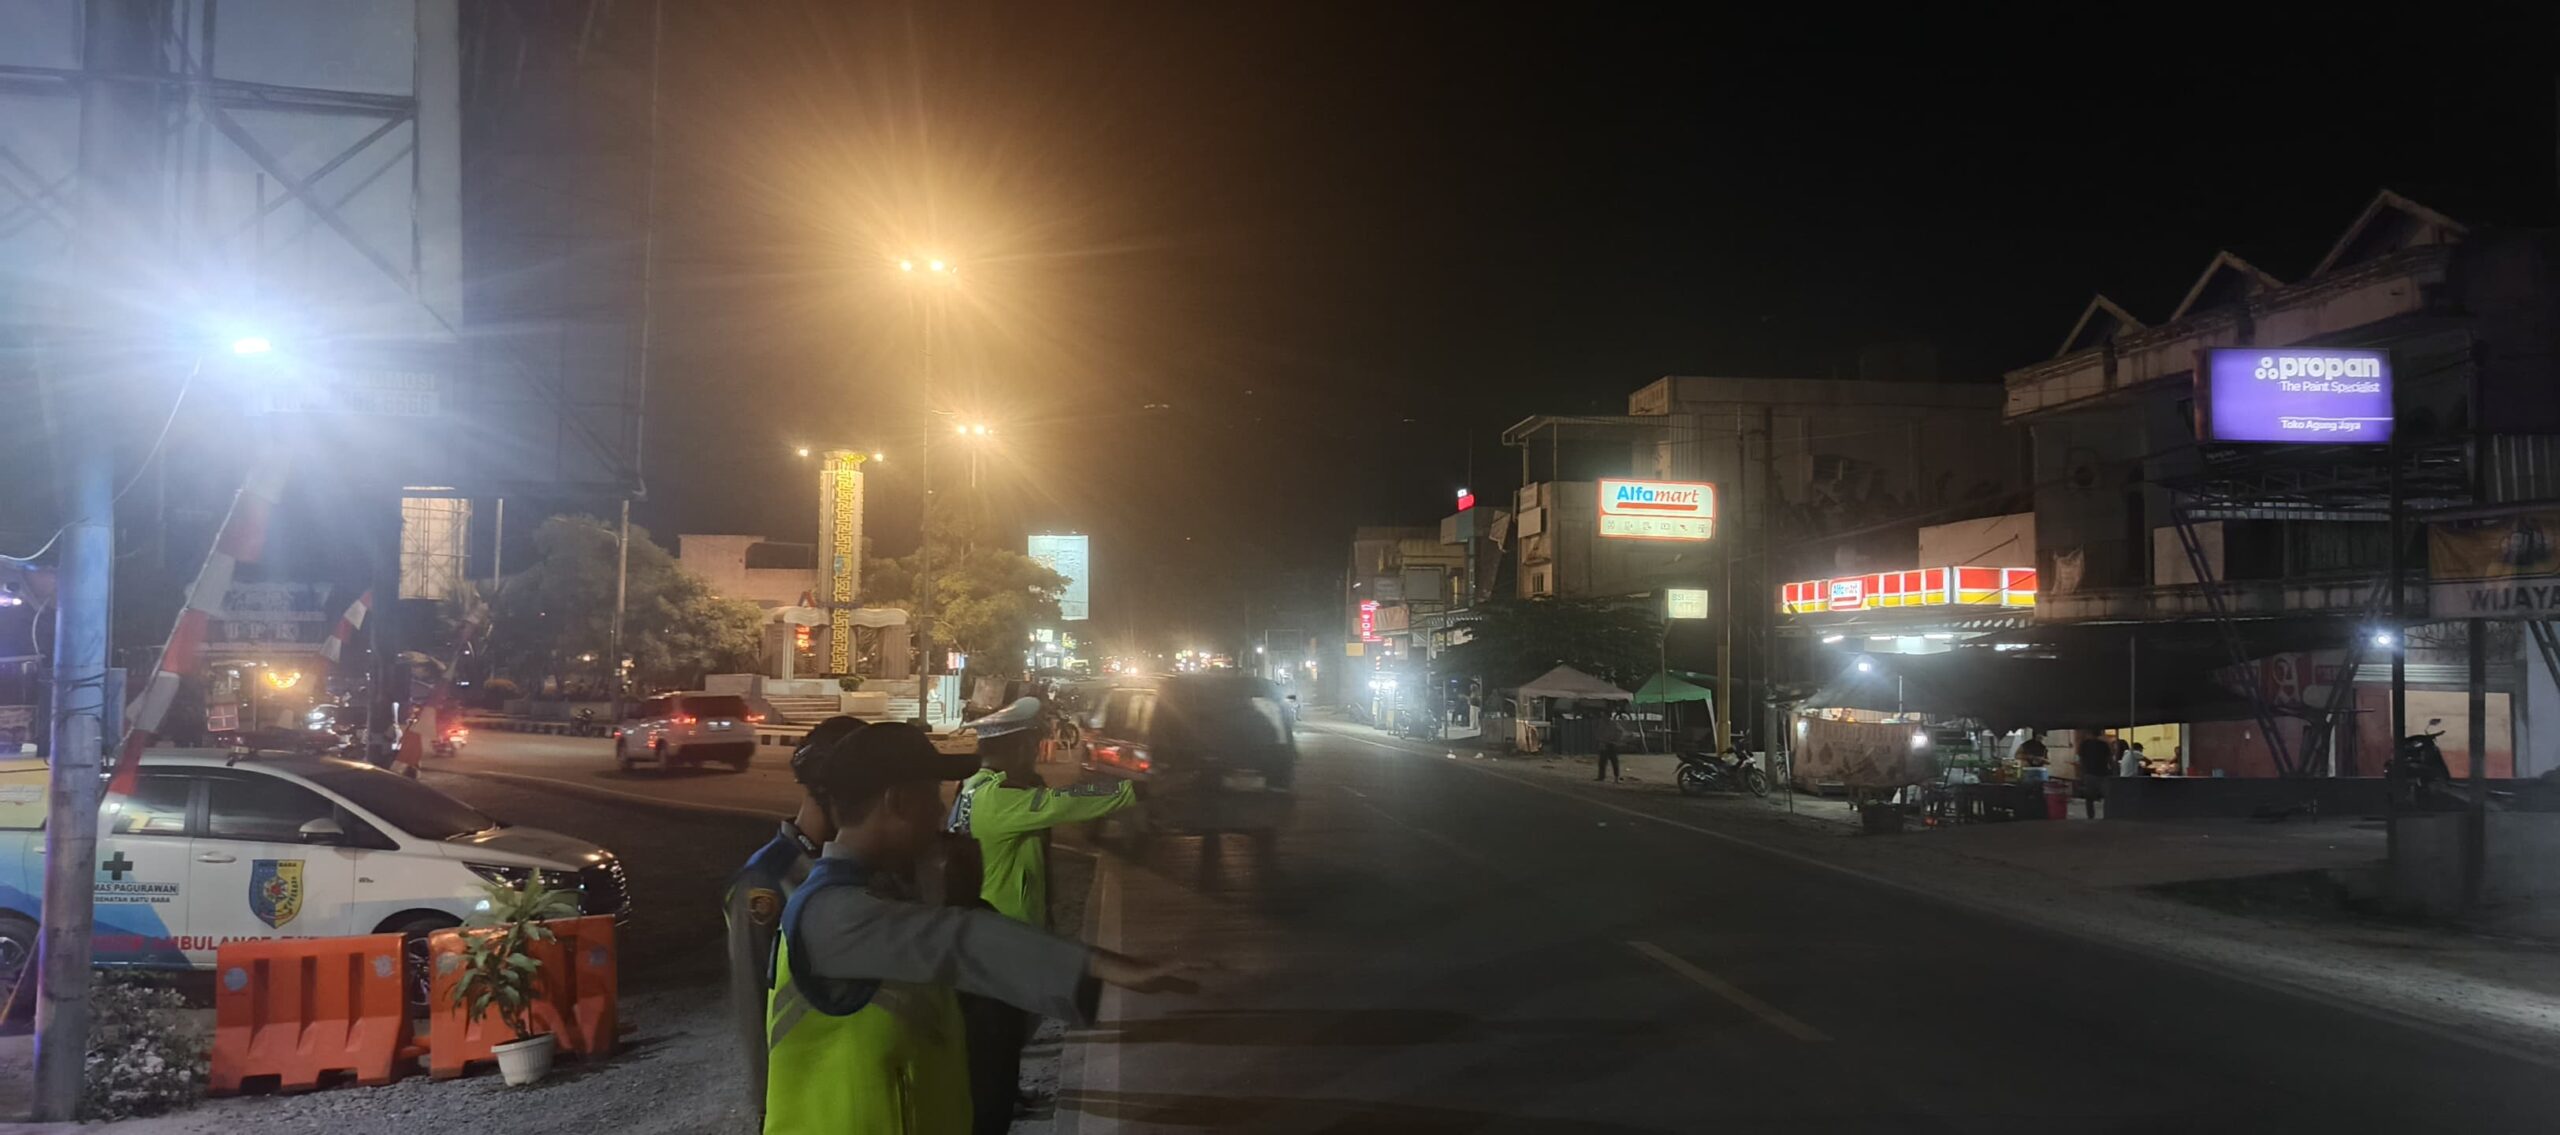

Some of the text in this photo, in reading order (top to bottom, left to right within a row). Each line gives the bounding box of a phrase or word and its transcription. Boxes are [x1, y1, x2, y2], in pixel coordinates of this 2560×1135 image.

[2279, 357, 2380, 380] propan
[2280, 381, 2301, 391] The
[2303, 381, 2329, 391] Paint
[2281, 421, 2305, 429] Toko
[1617, 485, 1700, 503] Alfamart
[114, 884, 177, 893] PAGURAWAN
